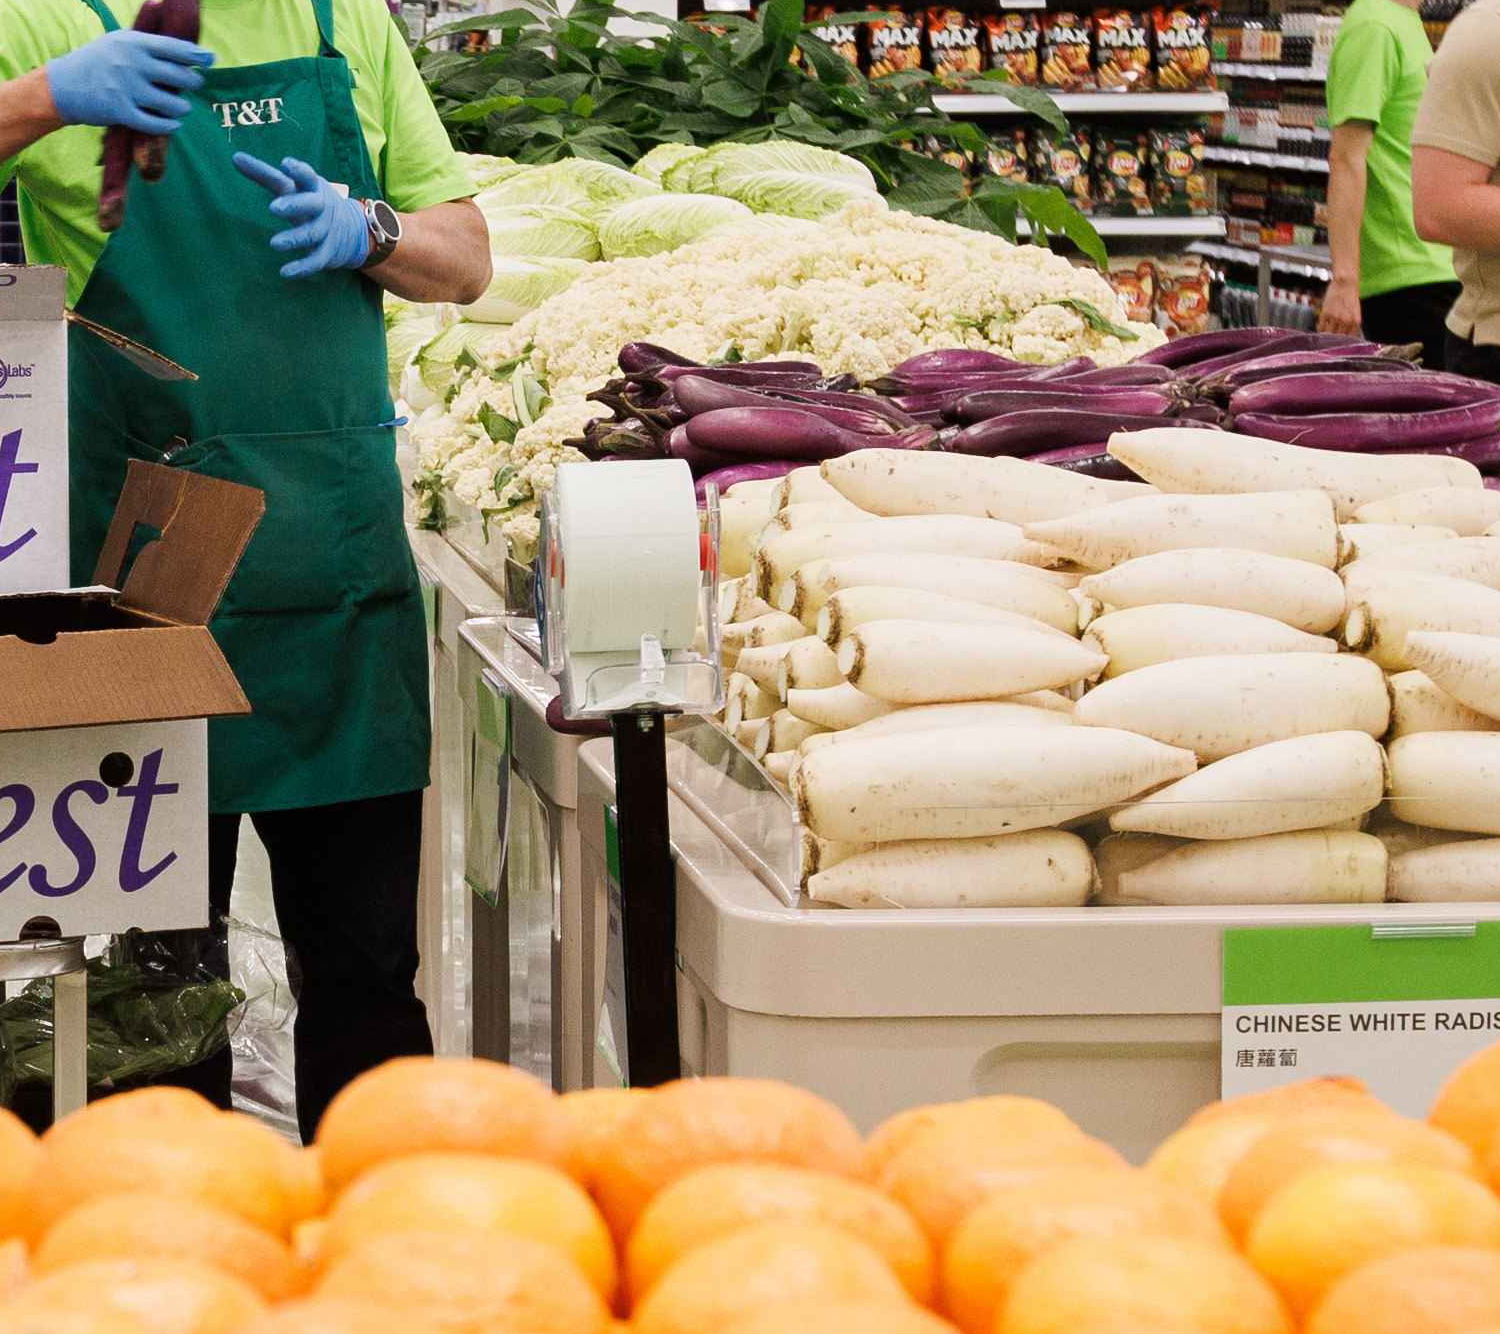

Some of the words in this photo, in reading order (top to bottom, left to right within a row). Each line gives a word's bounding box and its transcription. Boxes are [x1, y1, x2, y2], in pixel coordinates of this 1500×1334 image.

[872, 26, 920, 47] MAX
[929, 27, 980, 48] MAX
[991, 30, 1039, 53] MAX
[1043, 25, 1091, 45] MAX
[1100, 27, 1147, 48] MAX
[1157, 27, 1206, 48] MAX
[212, 98, 284, 127] T&T
[1235, 1013, 1342, 1034] CHINESE
[1349, 1012, 1427, 1032] WHITE
[1235, 1047, 1298, 1068] 唐蘿蔔
